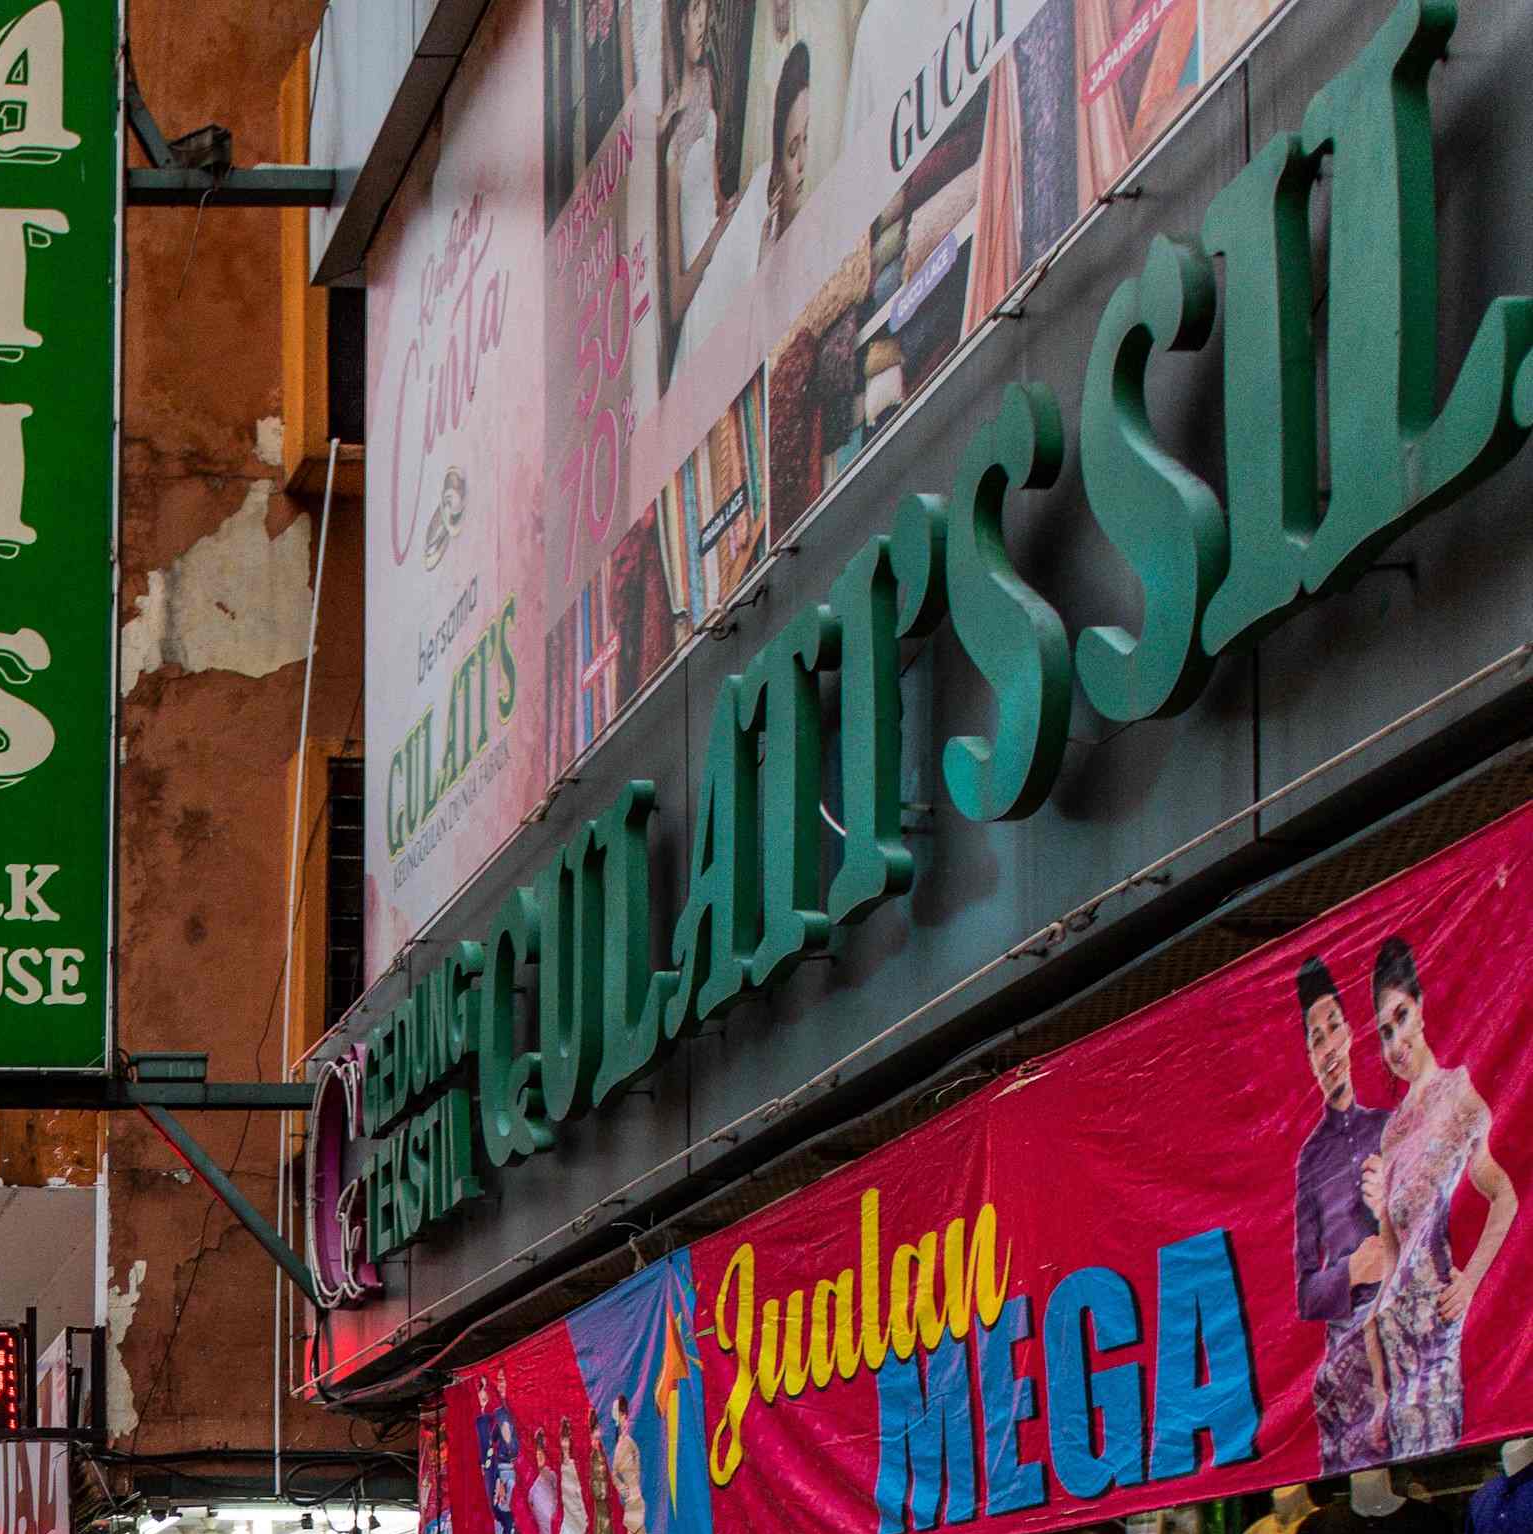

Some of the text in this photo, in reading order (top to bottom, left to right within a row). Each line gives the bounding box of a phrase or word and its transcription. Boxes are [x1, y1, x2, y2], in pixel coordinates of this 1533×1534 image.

[1089, 14, 1149, 91] JAPANESE
[557, 116, 634, 281] DISKAUN
[392, 214, 509, 566] Cinta
[1074, 0, 1533, 722] SIL
[388, 592, 516, 862] GULATI'S
[418, 574, 477, 686] bersama
[478, 380, 1072, 1169] GULATI'S
[363, 941, 485, 1138] GEDUNG
[360, 1090, 486, 1264] TEKSTIL
[709, 1188, 1012, 1486] Jualan
